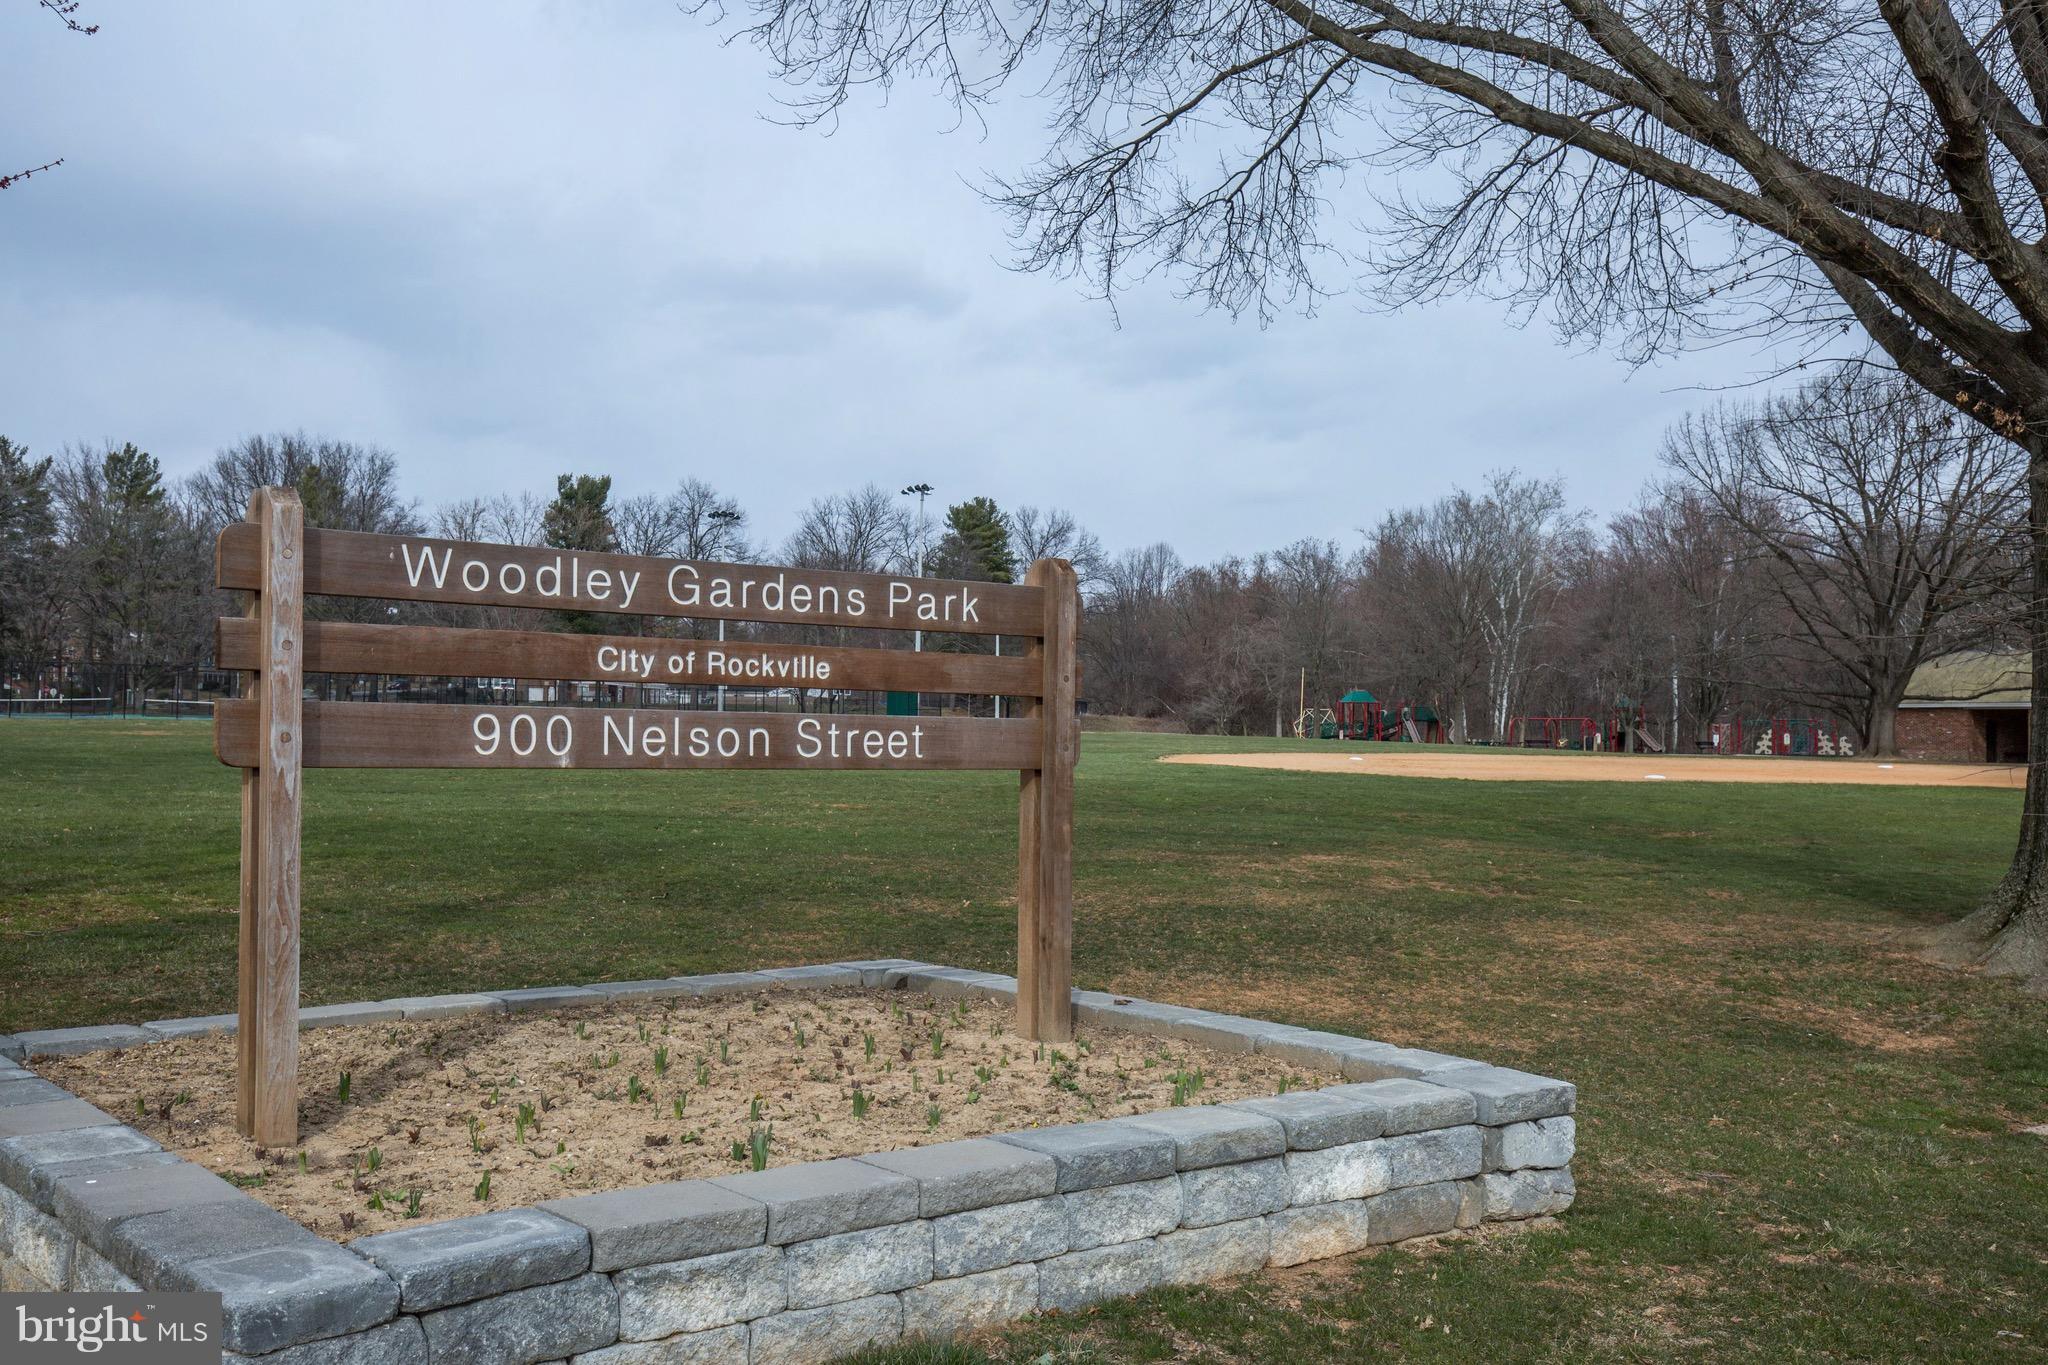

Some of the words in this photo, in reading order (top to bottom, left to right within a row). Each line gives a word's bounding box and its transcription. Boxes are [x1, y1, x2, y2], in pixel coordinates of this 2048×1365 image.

[401, 544, 642, 608] Woodley
[667, 564, 866, 618] Gardens
[888, 581, 980, 623] Park
[597, 646, 655, 678] City
[668, 652, 696, 674] of
[707, 651, 831, 680] Rockville
[473, 712, 574, 757] 900
[603, 715, 770, 758] Nelson
[796, 718, 925, 759] Street
